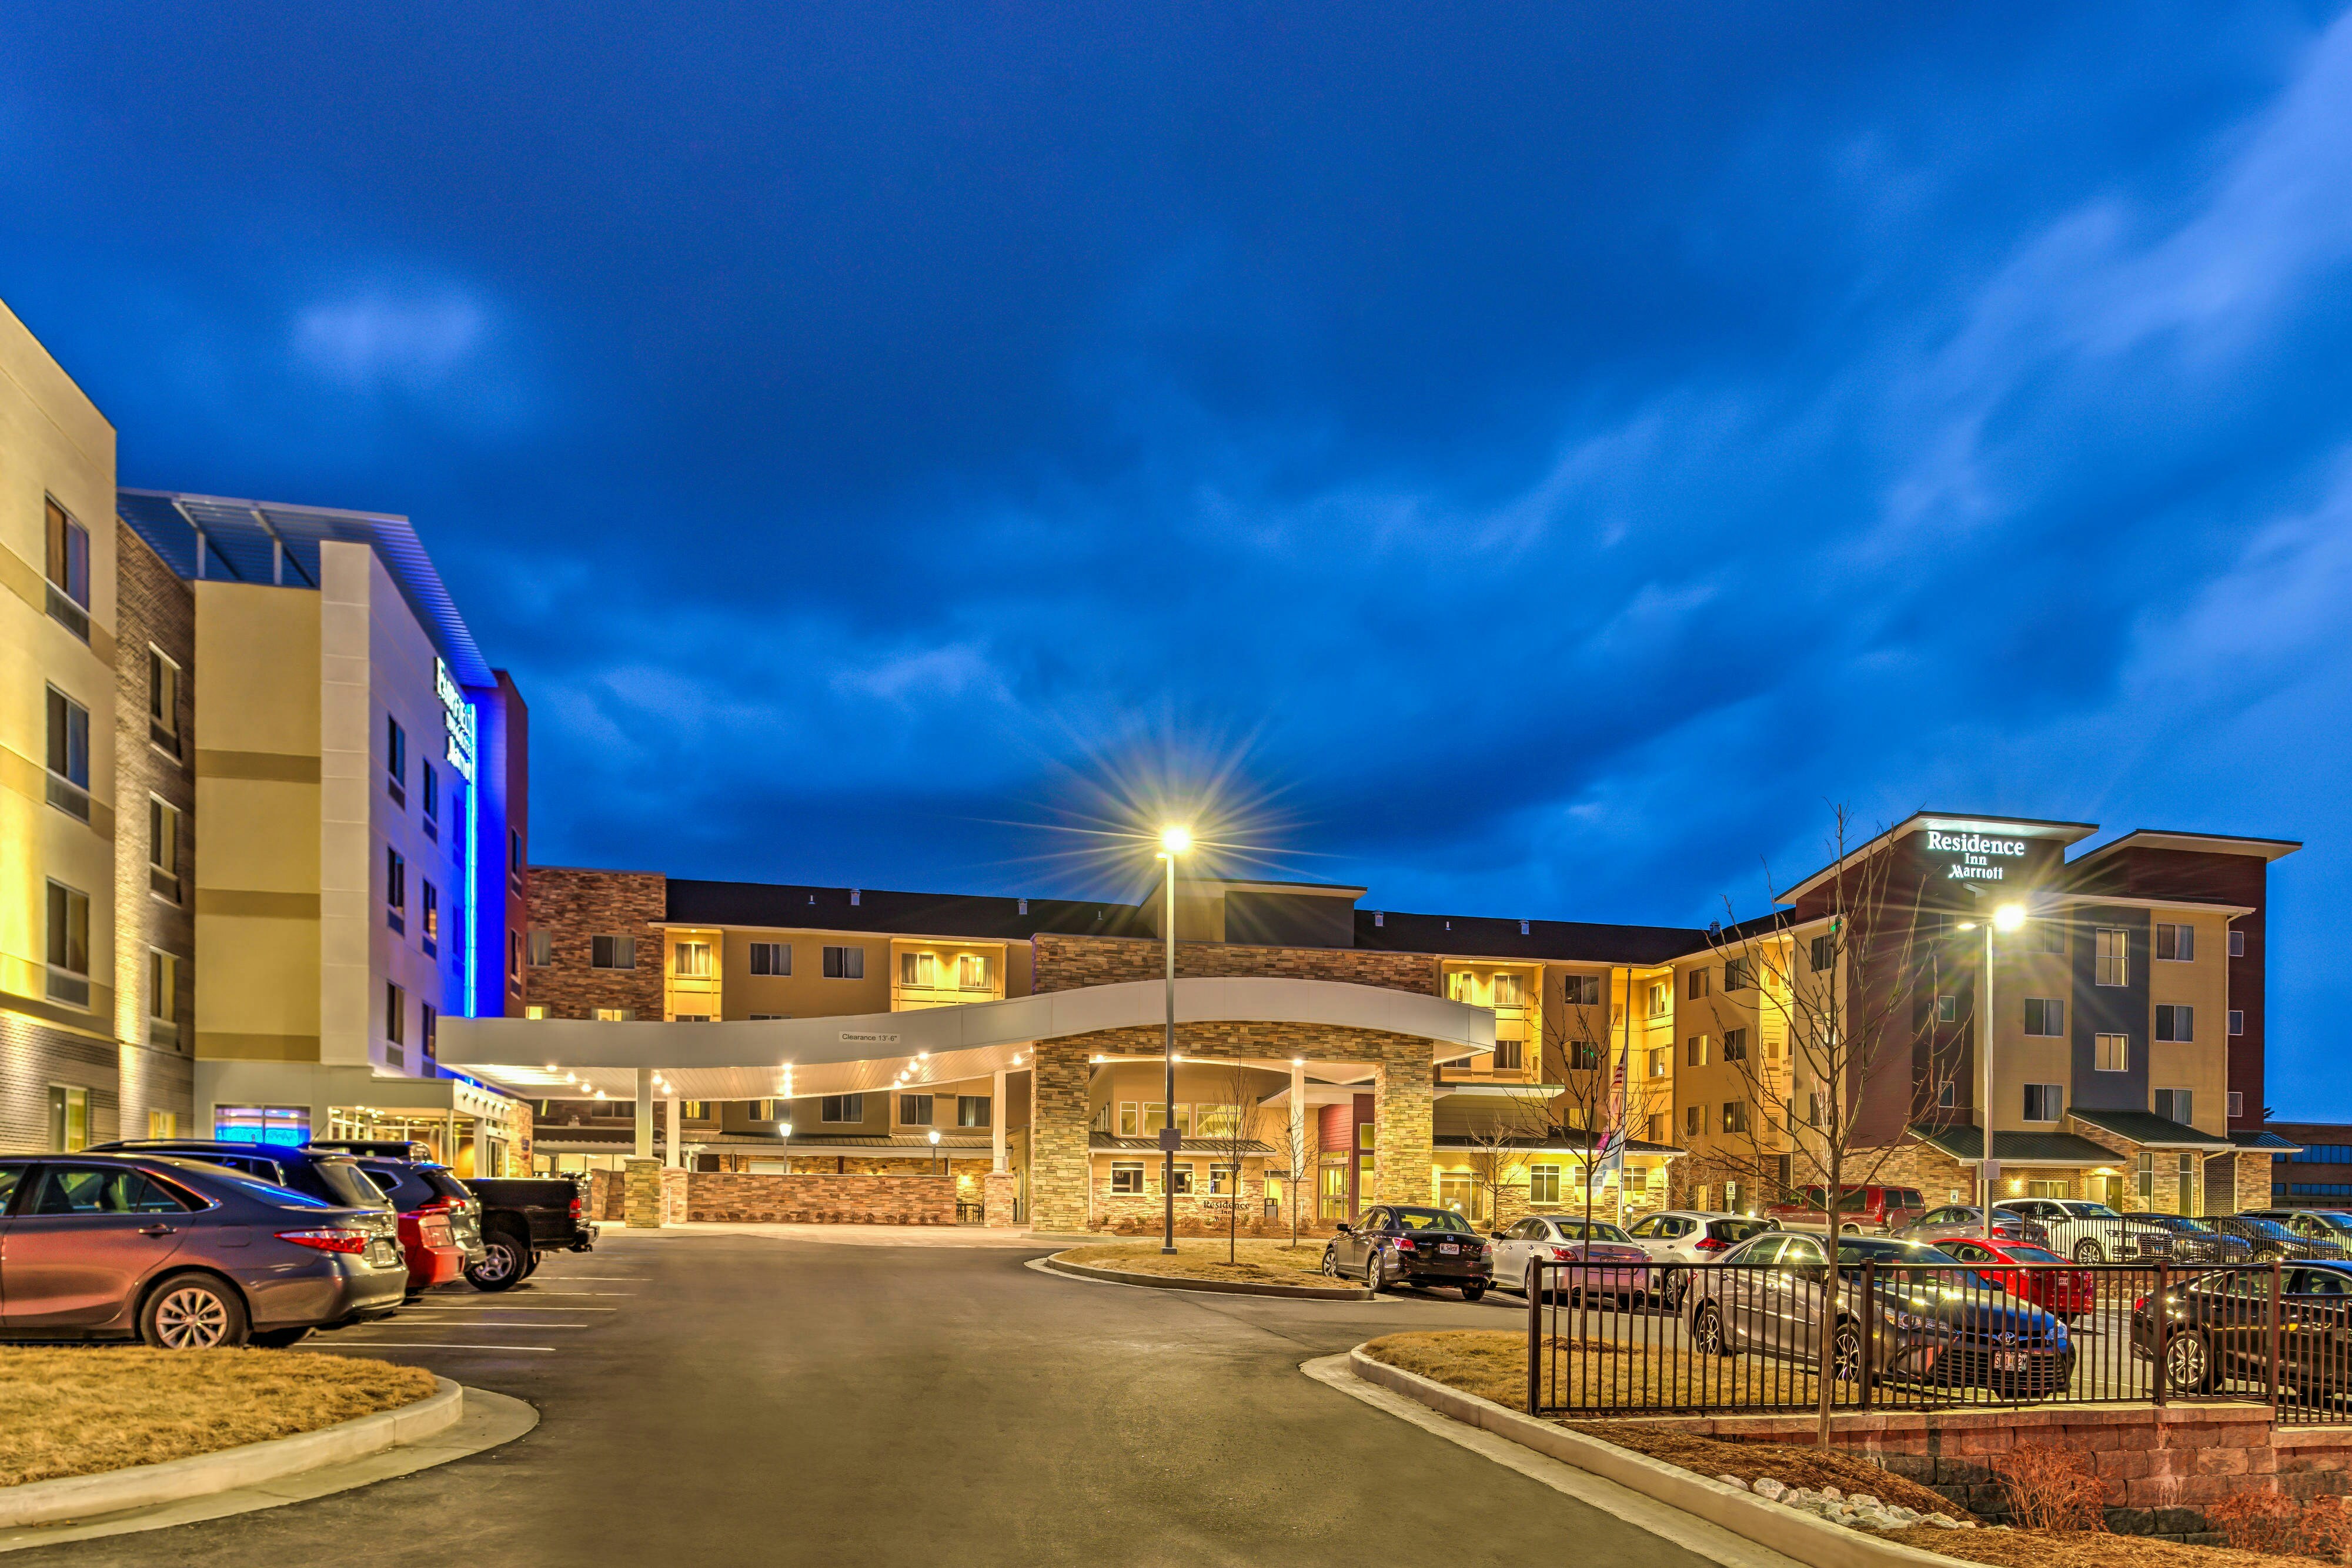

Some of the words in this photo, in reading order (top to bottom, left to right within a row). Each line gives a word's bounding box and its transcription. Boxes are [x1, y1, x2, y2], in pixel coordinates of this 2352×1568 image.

[1927, 831, 2025, 856] Residence
[1965, 852, 1987, 866] Inn
[1947, 864, 2003, 880] Marriott
[1202, 1200, 1250, 1209] Residence
